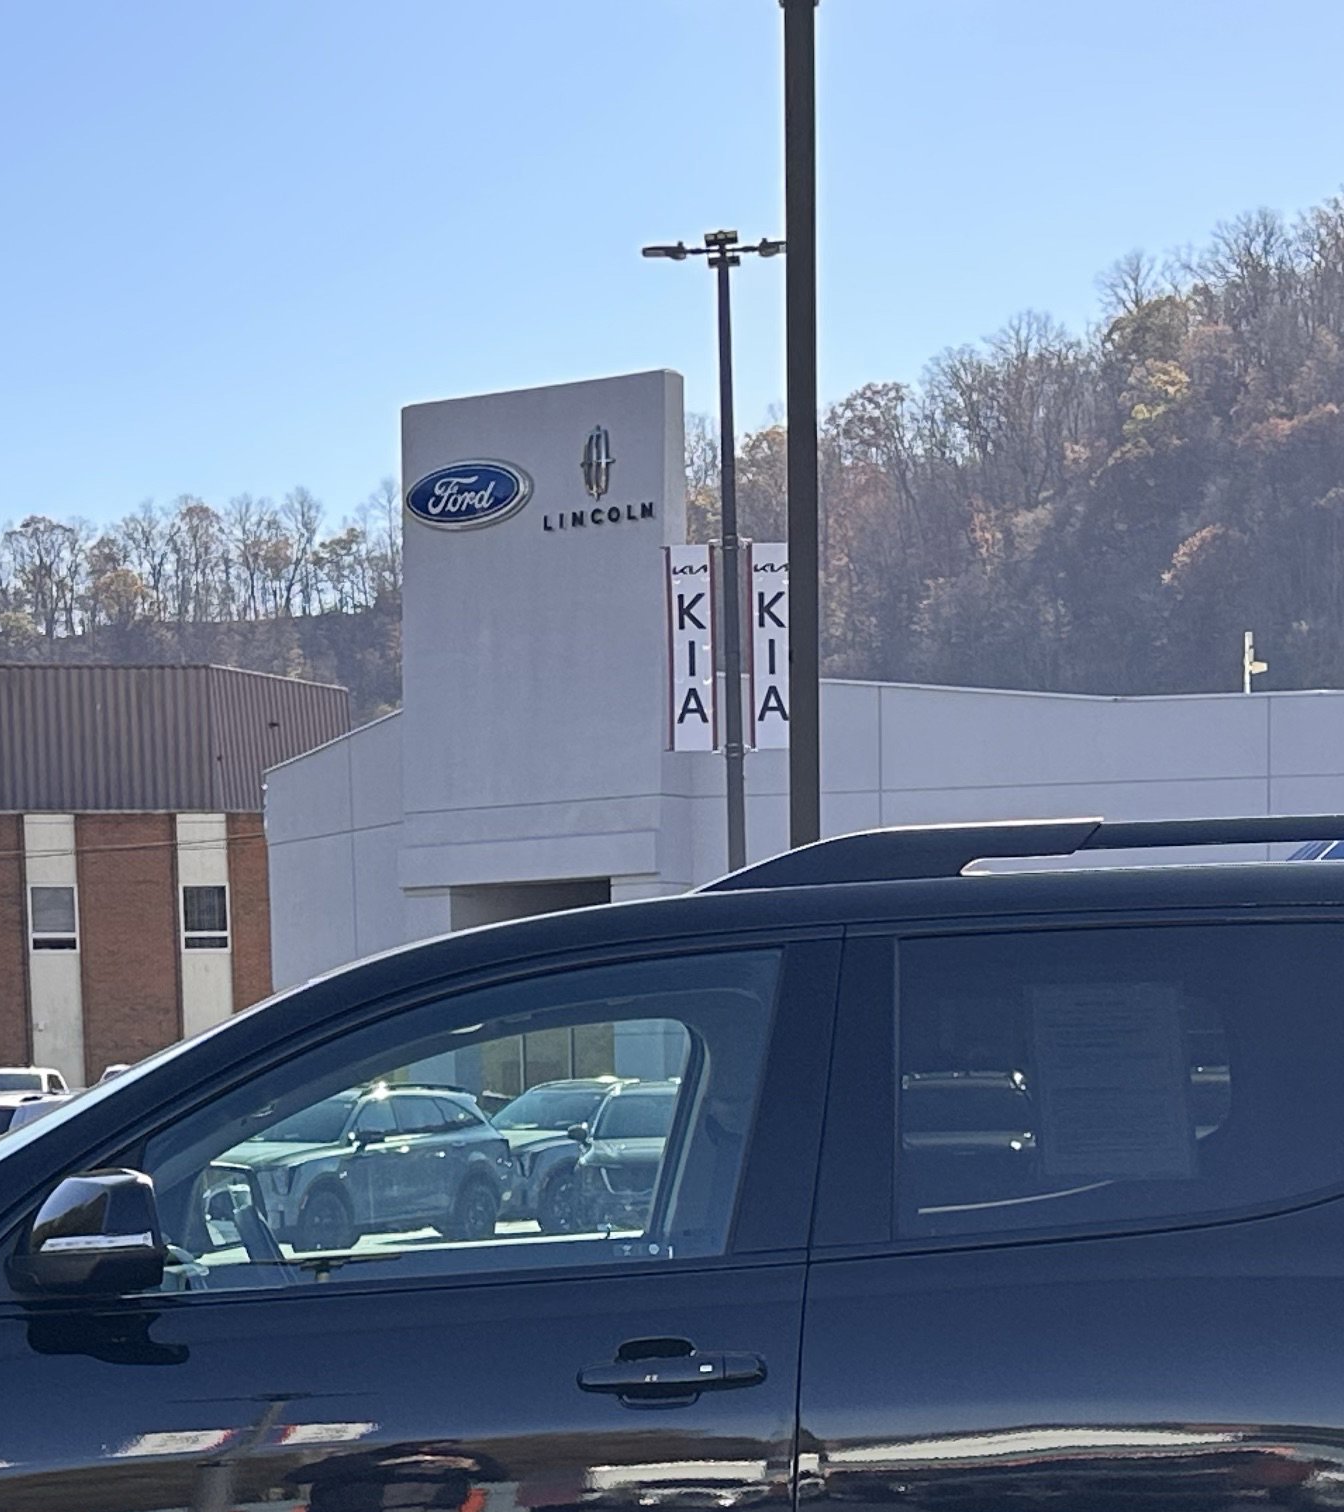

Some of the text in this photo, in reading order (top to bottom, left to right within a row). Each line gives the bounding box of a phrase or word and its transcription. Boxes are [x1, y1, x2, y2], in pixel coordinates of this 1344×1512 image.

[427, 475, 497, 515] Ford
[543, 502, 654, 531] LINCOLN
[677, 593, 709, 724] KIA
[757, 591, 790, 722] KIA
